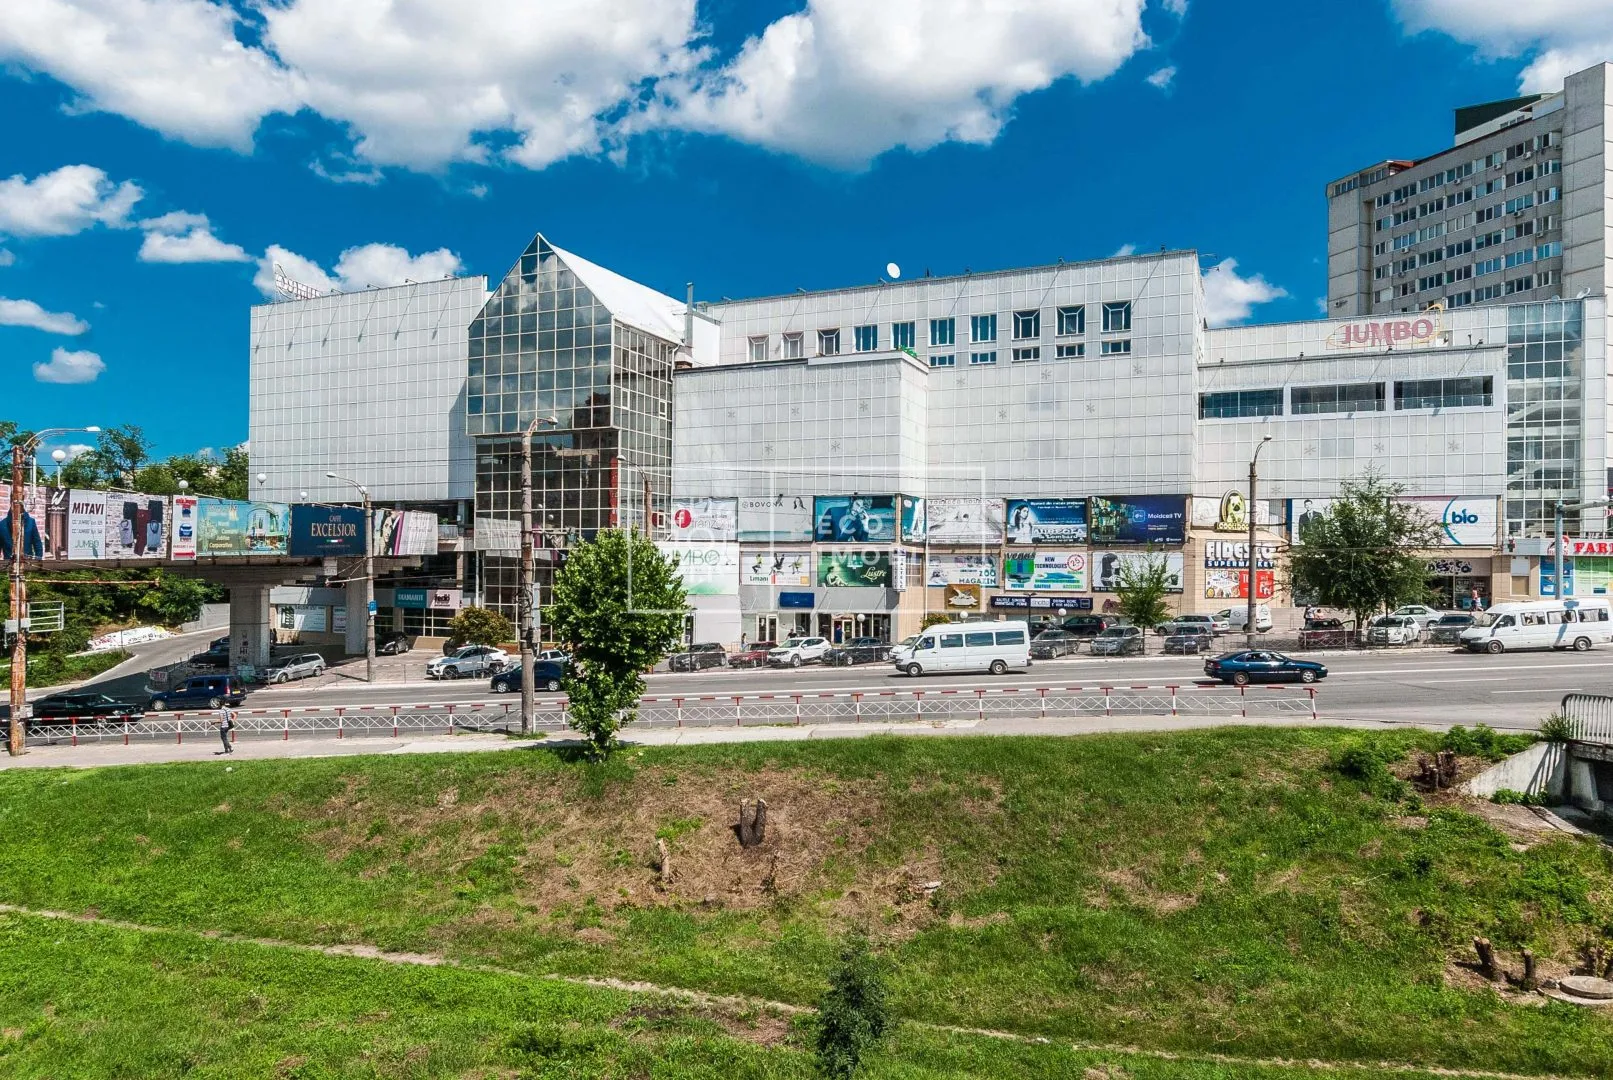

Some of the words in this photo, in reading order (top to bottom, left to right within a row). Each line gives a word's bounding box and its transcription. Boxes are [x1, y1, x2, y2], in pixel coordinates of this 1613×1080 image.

[1341, 318, 1434, 347] JUMBO
[71, 502, 105, 515] MITAVI
[1451, 508, 1479, 524] bio
[311, 522, 357, 537] EXCELSIOR
[1573, 542, 1613, 554] FAR
[860, 566, 888, 583] Lustre
[958, 577, 997, 585] MAGAZIN
